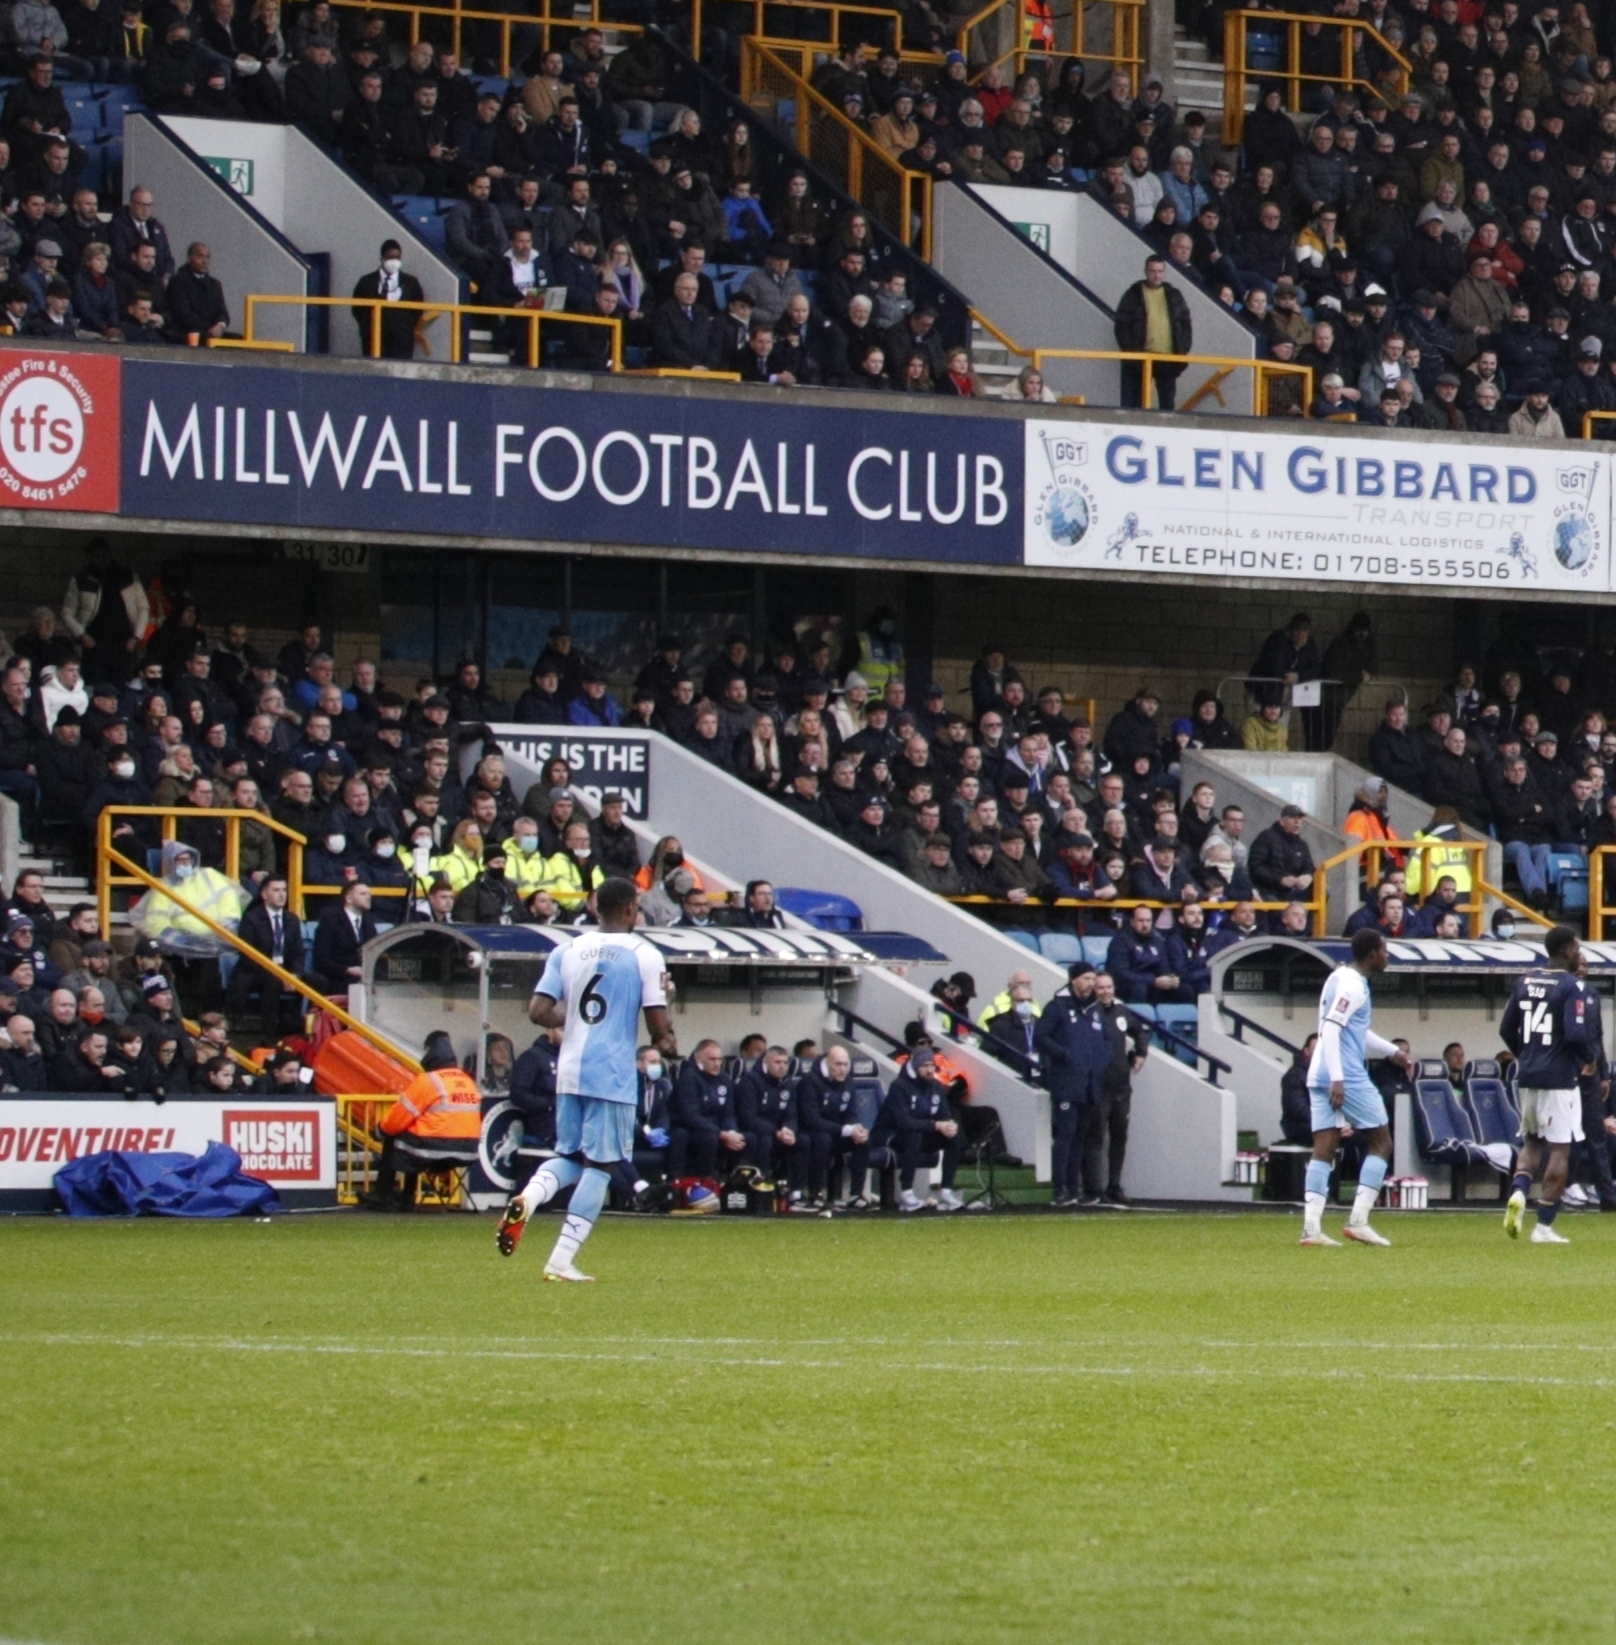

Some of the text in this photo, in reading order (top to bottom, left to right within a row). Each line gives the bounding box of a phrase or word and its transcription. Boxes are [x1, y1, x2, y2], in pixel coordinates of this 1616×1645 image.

[22, 359, 45, 373] Fire
[48, 360, 56, 373] &
[58, 365, 94, 415] Security
[10, 404, 74, 454] tfs
[139, 400, 1008, 527] MILLWALL FOOTBALL CLUB
[1056, 442, 1084, 462] GGT
[0, 466, 88, 501] 020 8461 5476
[1104, 434, 1538, 505] GLEN GIBBARD
[1560, 472, 1587, 489] GGT
[1034, 473, 1098, 526] GLEN GIBBARD
[1554, 501, 1585, 517] GLEN
[1352, 503, 1535, 531] TRANSPORT
[1163, 524, 1485, 550] NATIONAL & INTERNATIONAL LOGISTICS
[1135, 544, 1510, 580] TELEPHONE: 01708-555506
[496, 741, 645, 772] HIS IS THE
[582, 784, 642, 814] DN
[579, 948, 621, 963] GUEHI
[578, 973, 608, 1025] 6
[1518, 1000, 1553, 1046] 14
[230, 1121, 312, 1153] HUSKI
[240, 1155, 312, 1171] HOCOLATE
